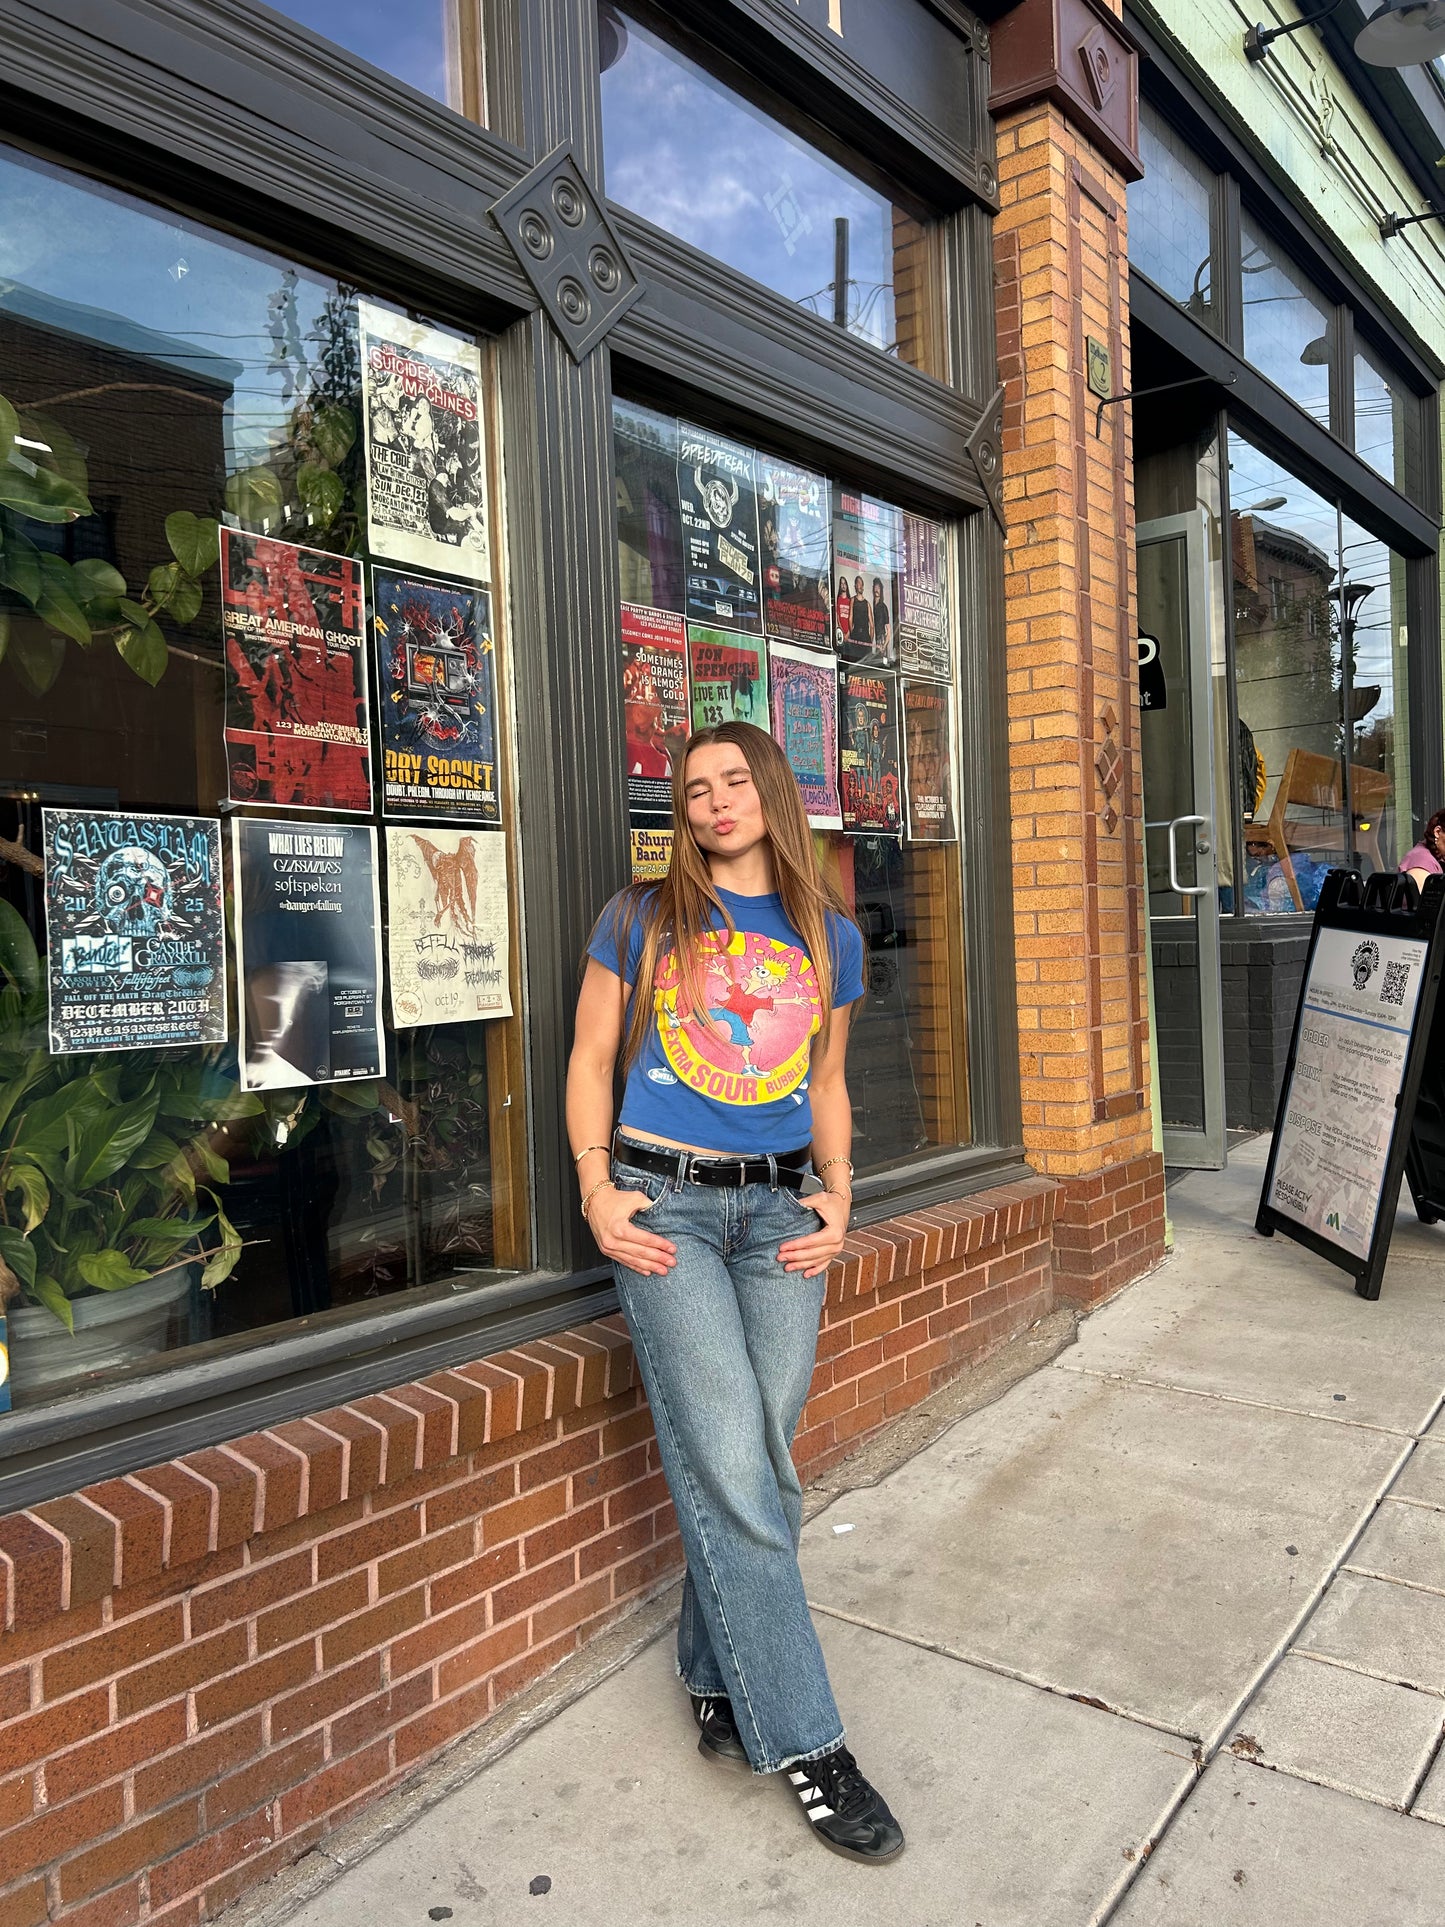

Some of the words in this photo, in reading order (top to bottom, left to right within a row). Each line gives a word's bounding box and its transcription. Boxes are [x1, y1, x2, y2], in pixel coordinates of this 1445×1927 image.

[372, 350, 427, 381] SUICIDE
[405, 378, 474, 418] MACHINES
[373, 445, 389, 462] THE
[391, 451, 411, 469] CODE
[681, 441, 751, 483] SPEEDFREAK
[416, 490, 425, 500] 21
[694, 517, 711, 531] 22ND
[631, 606, 644, 615] PARTY
[224, 611, 263, 627] GREAT
[265, 618, 324, 639] AMERICAN
[326, 630, 363, 647] GHOST
[648, 623, 668, 632] PLEASANT
[656, 618, 674, 626] OCTOBER
[767, 622, 779, 634] 123
[636, 652, 683, 669] SOMETIMES
[697, 648, 723, 661] JON
[651, 666, 684, 680] ORANGE
[695, 661, 756, 677] SPENCER!
[642, 675, 650, 685] IS
[652, 677, 684, 690] ALMOST
[848, 675, 863, 686] THE
[862, 678, 887, 691] LOCAL
[663, 690, 685, 700] GOLD
[694, 686, 714, 702] LIVE
[717, 685, 728, 701] AT
[848, 684, 887, 703] HONEYS
[703, 705, 724, 724] 123
[276, 721, 292, 729] 123
[294, 723, 337, 735] PLEASANT
[338, 728, 368, 740] STREET
[318, 721, 360, 734] NOVEMBER
[294, 729, 354, 743] MORGANTOWN,
[386, 749, 422, 784] DRY
[427, 755, 493, 791] SOCKET
[268, 833, 293, 855] WHAT
[294, 834, 313, 856] LIES
[313, 836, 344, 858] BELOW
[51, 820, 211, 897] SANTASLAM
[636, 847, 666, 861] Band
[648, 864, 658, 874] 24,
[275, 875, 342, 897] softspoken
[64, 896, 87, 911] 20
[185, 898, 205, 912] 25
[146, 938, 197, 953] CASTLE
[135, 950, 210, 966] GRAYSKULL
[69, 975, 109, 983] ABSOLUTE
[450, 993, 459, 1007] 19
[61, 1002, 164, 1019] DECEMBER
[168, 999, 210, 1015] 20TH
[111, 1016, 166, 1024] 7:00PM
[86, 1036, 123, 1044] PLEASANT
[1302, 1028, 1329, 1048] ORDER
[1354, 1041, 1373, 1052] beverage
[665, 1030, 694, 1076] EXTRA
[690, 1063, 758, 1102] SOUR
[766, 1064, 804, 1094] BUBBLE
[1374, 1055, 1391, 1064] location
[1297, 1062, 1322, 1082] DRINK
[1341, 1076, 1359, 1087] beverage
[1362, 1091, 1386, 1103] designated
[1288, 1111, 1323, 1137] DISPOSE
[1352, 1145, 1378, 1160] participating
[1276, 1179, 1294, 1196] PLEASE
[1275, 1189, 1308, 1214] RESPONSIBLY
